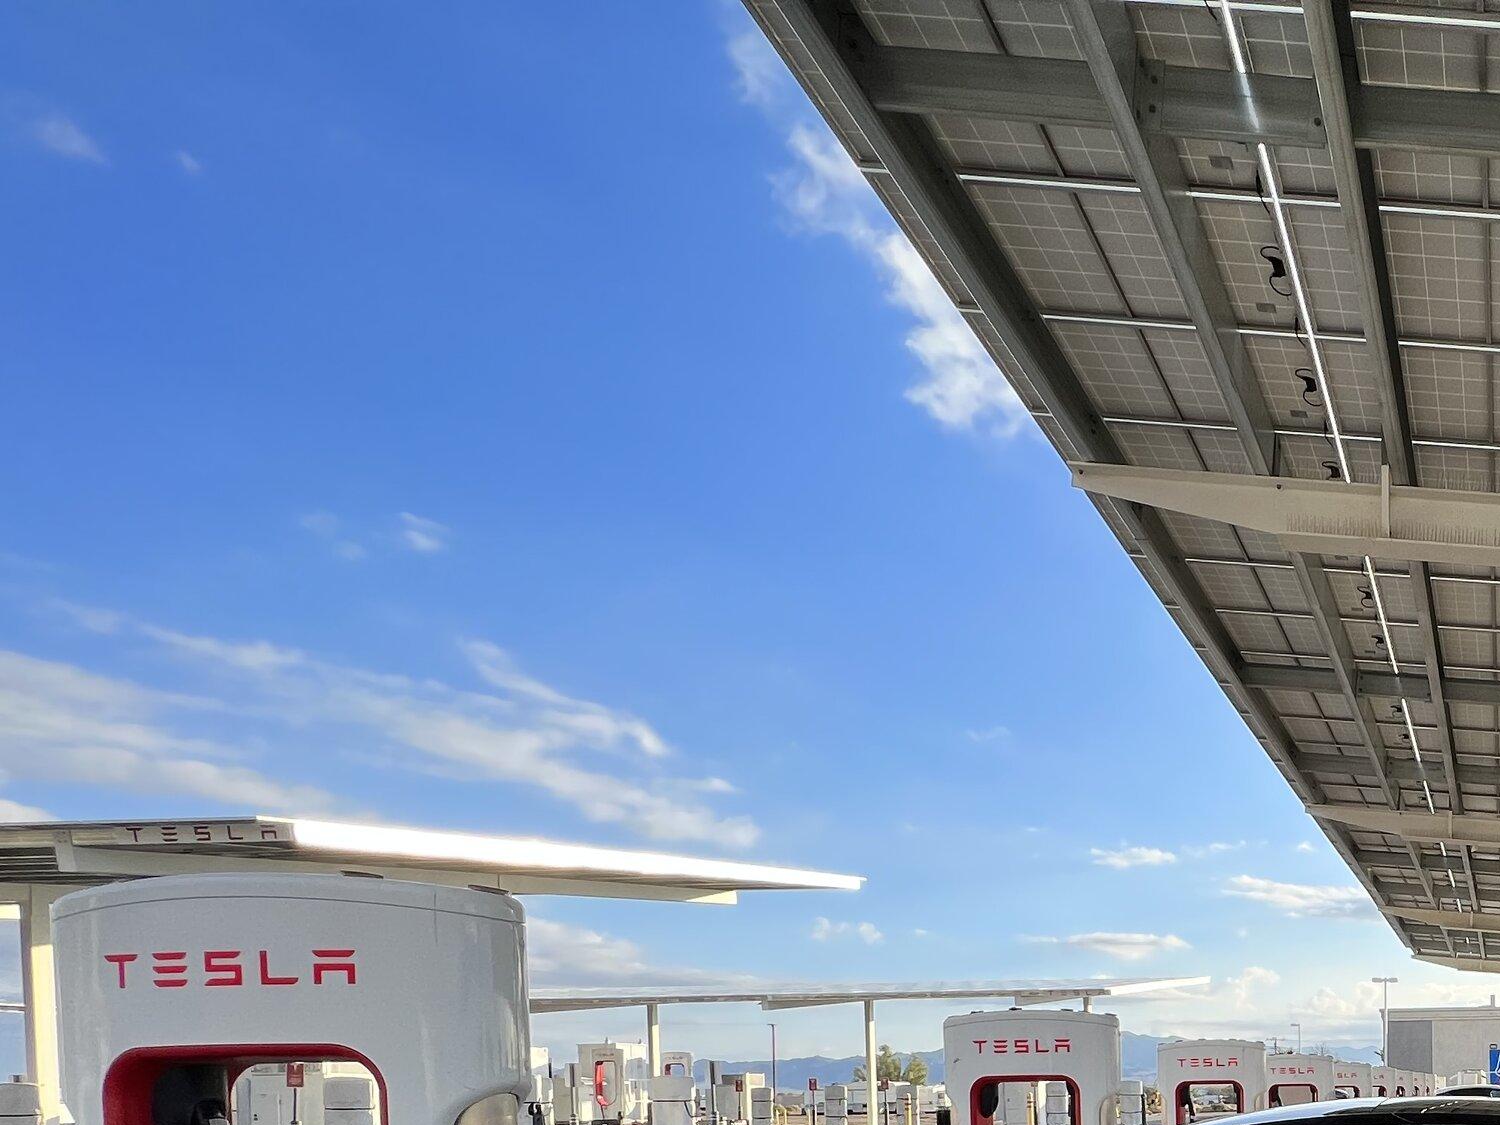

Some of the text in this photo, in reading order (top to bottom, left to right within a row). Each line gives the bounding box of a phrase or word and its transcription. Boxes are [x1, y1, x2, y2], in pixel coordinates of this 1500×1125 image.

[126, 825, 278, 842] TESLA
[104, 950, 356, 989] TESLA
[972, 1039, 1071, 1054] TESLA
[1177, 1057, 1238, 1067] TESLA
[1270, 1067, 1315, 1075] TESLA
